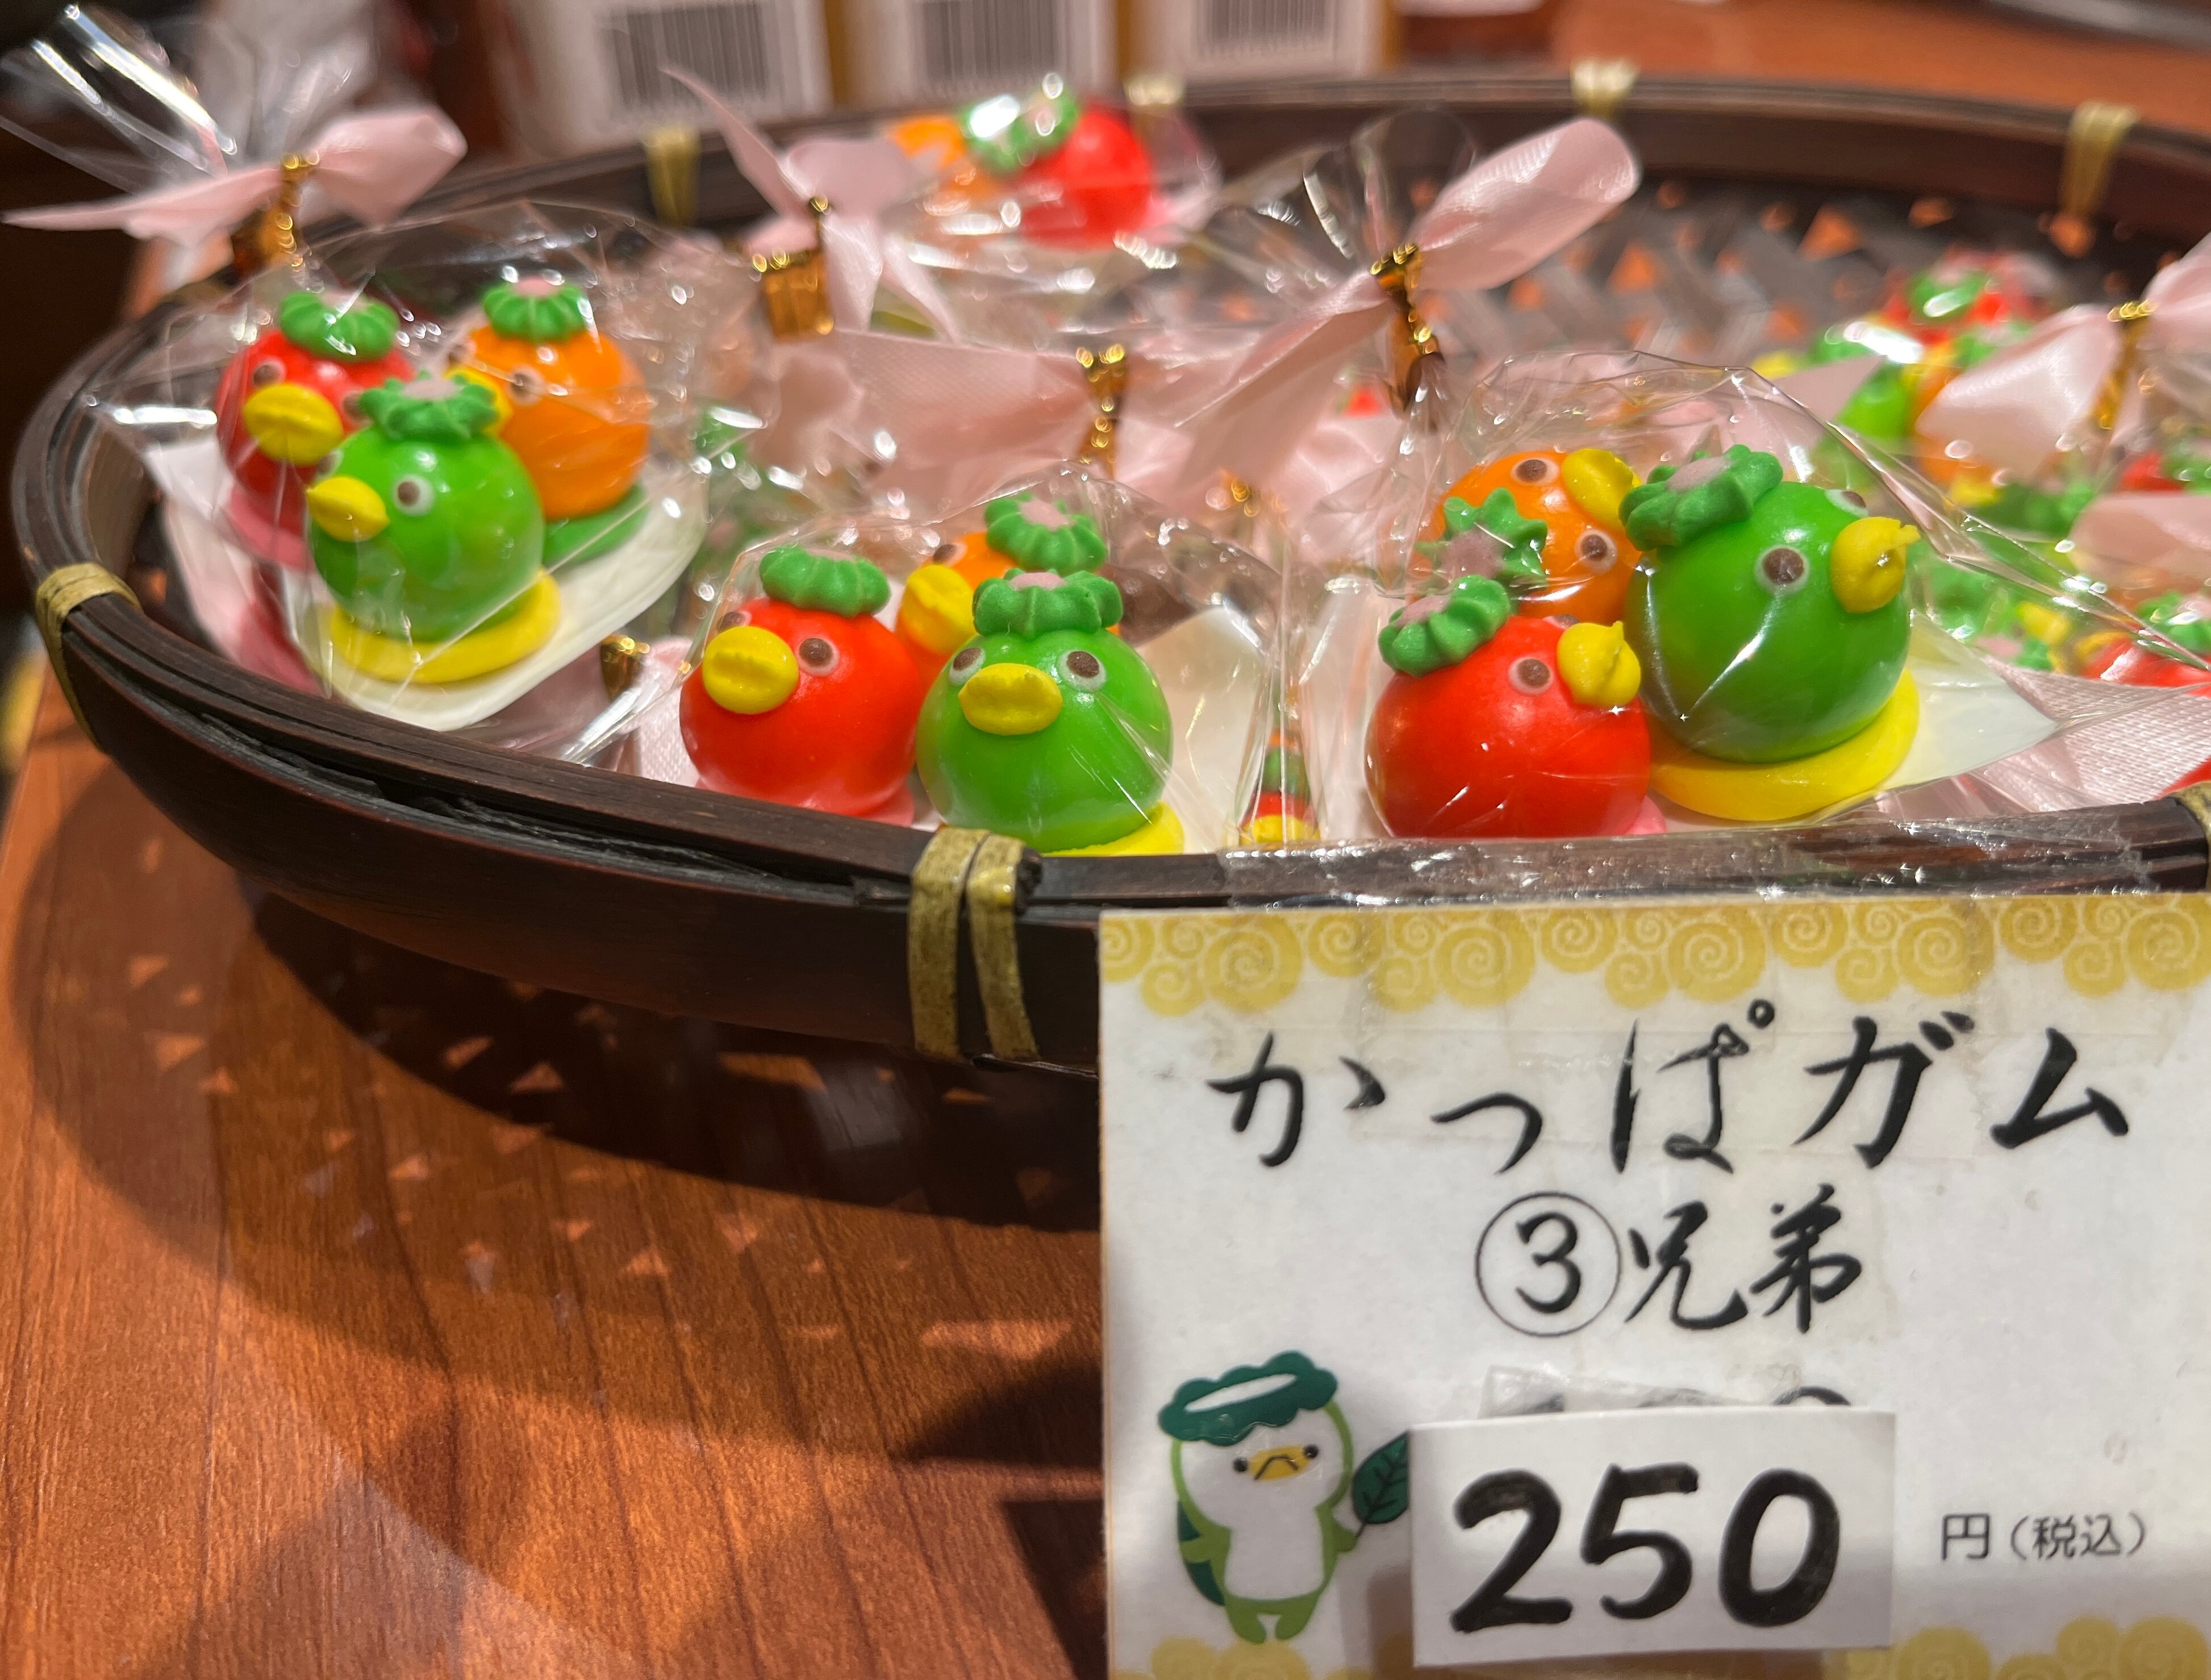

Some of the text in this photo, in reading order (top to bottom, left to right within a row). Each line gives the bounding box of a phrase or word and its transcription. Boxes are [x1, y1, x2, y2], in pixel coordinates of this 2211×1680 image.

[1210, 999, 2129, 1173] かっぱガム
[1450, 1466, 1840, 1635] 250
